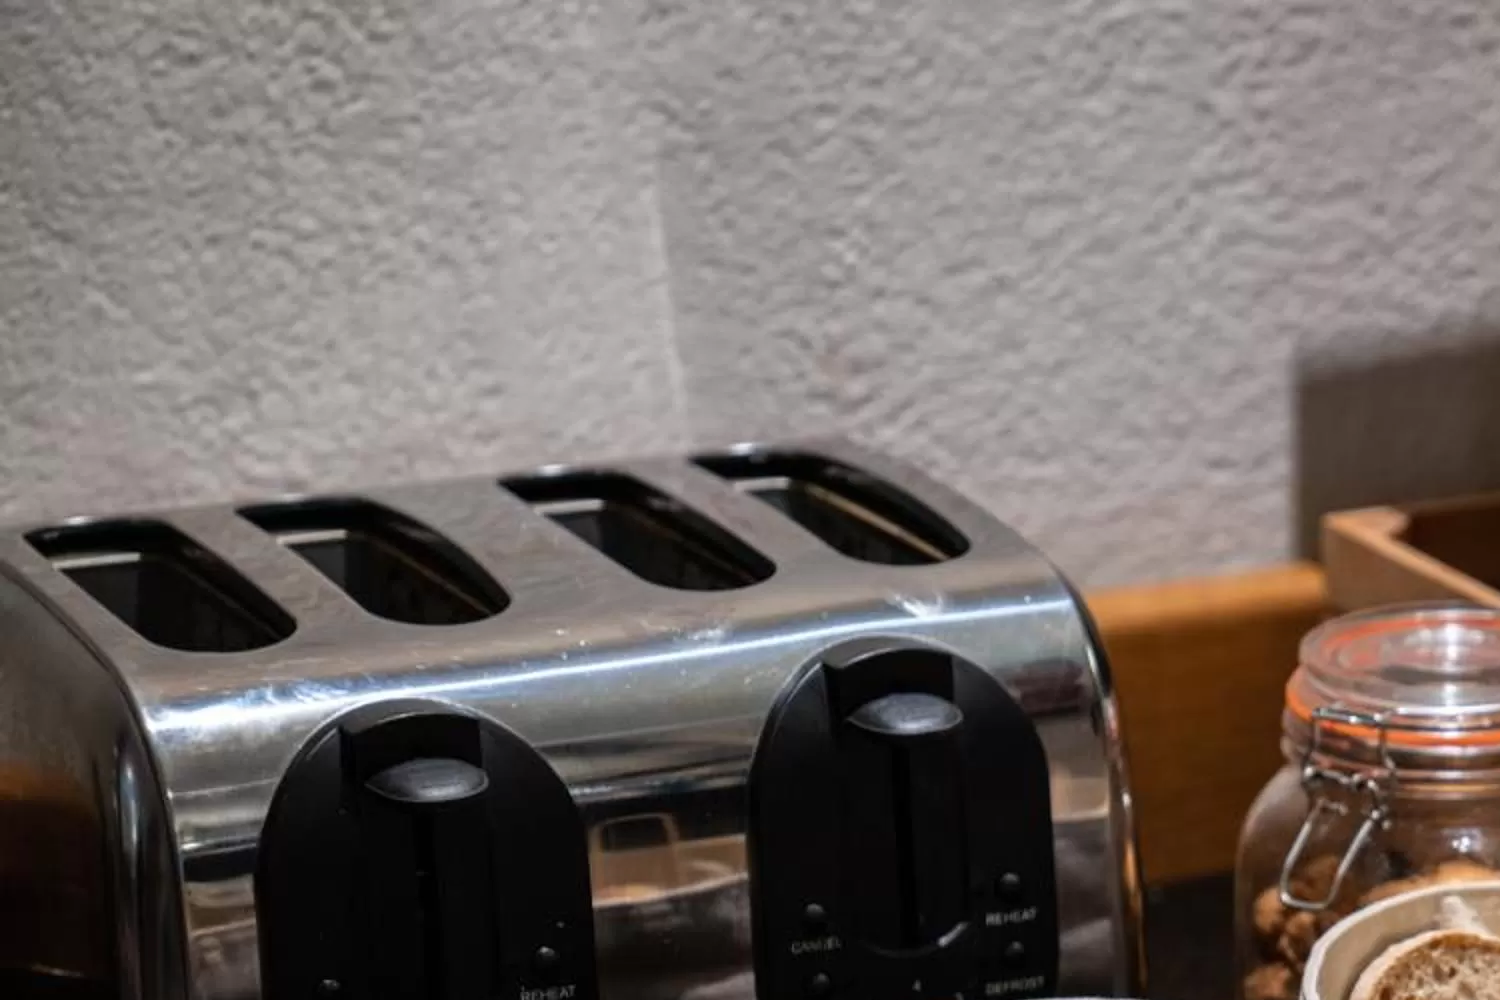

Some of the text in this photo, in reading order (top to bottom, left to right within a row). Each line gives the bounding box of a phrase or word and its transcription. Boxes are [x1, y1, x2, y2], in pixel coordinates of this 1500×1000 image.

[985, 906, 1037, 926] REHEAT
[791, 936, 841, 954] CANCEL
[985, 975, 1046, 995] DEFROST
